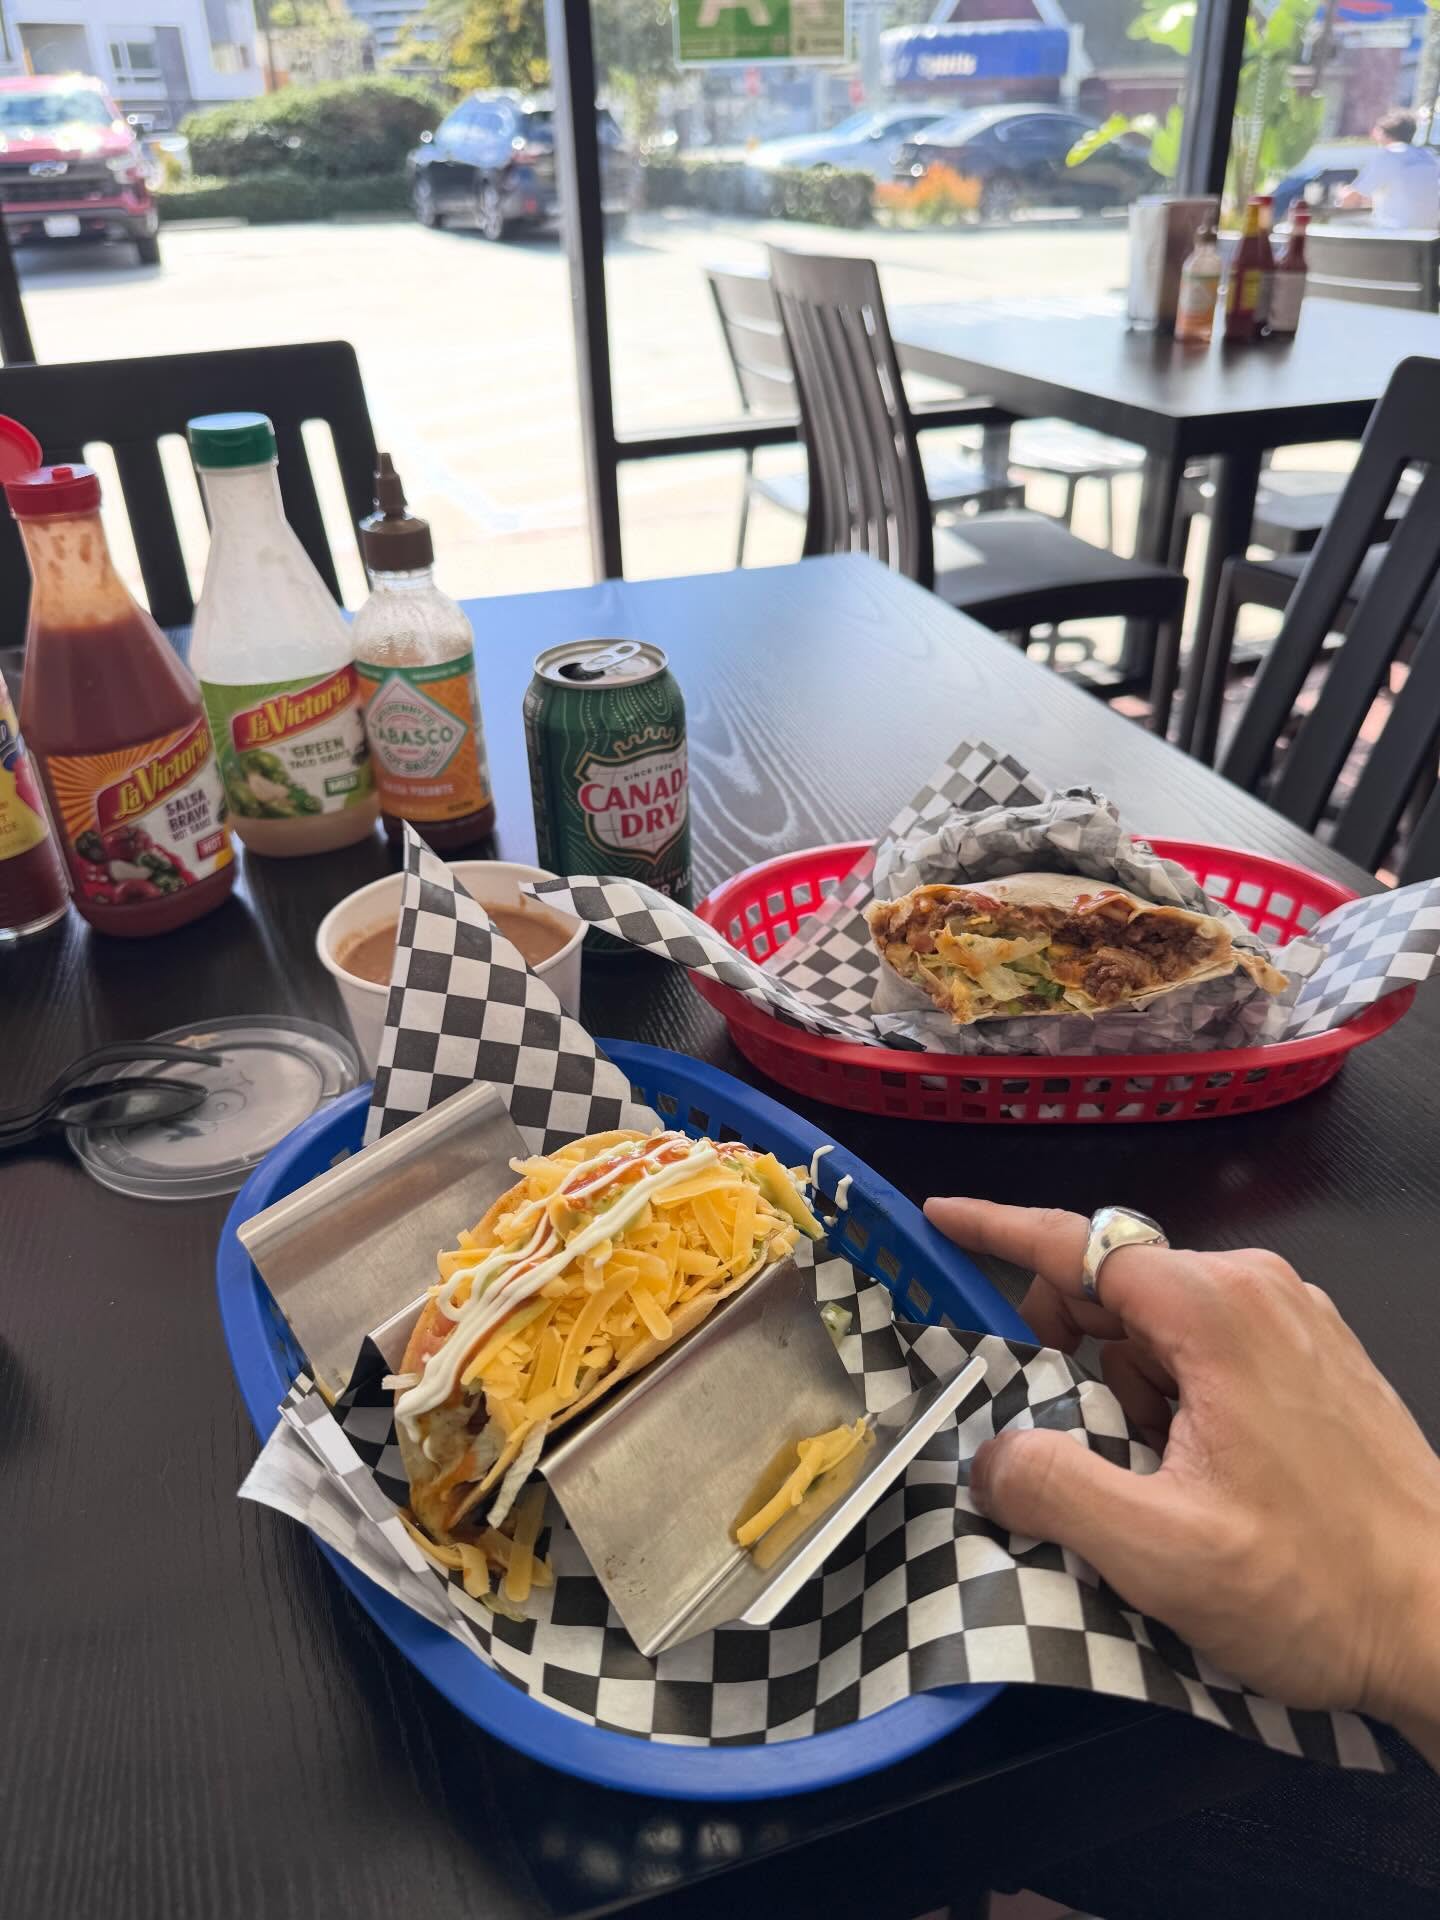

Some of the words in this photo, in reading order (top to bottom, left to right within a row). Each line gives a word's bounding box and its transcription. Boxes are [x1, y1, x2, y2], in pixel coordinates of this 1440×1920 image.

[264, 676, 351, 734] Victoria
[292, 736, 343, 758] GREEN
[290, 757, 317, 769] TACO
[624, 767, 651, 781] SINCE
[166, 788, 207, 817] SALSA
[169, 804, 209, 834] BRAVA
[621, 801, 679, 838] DRY
